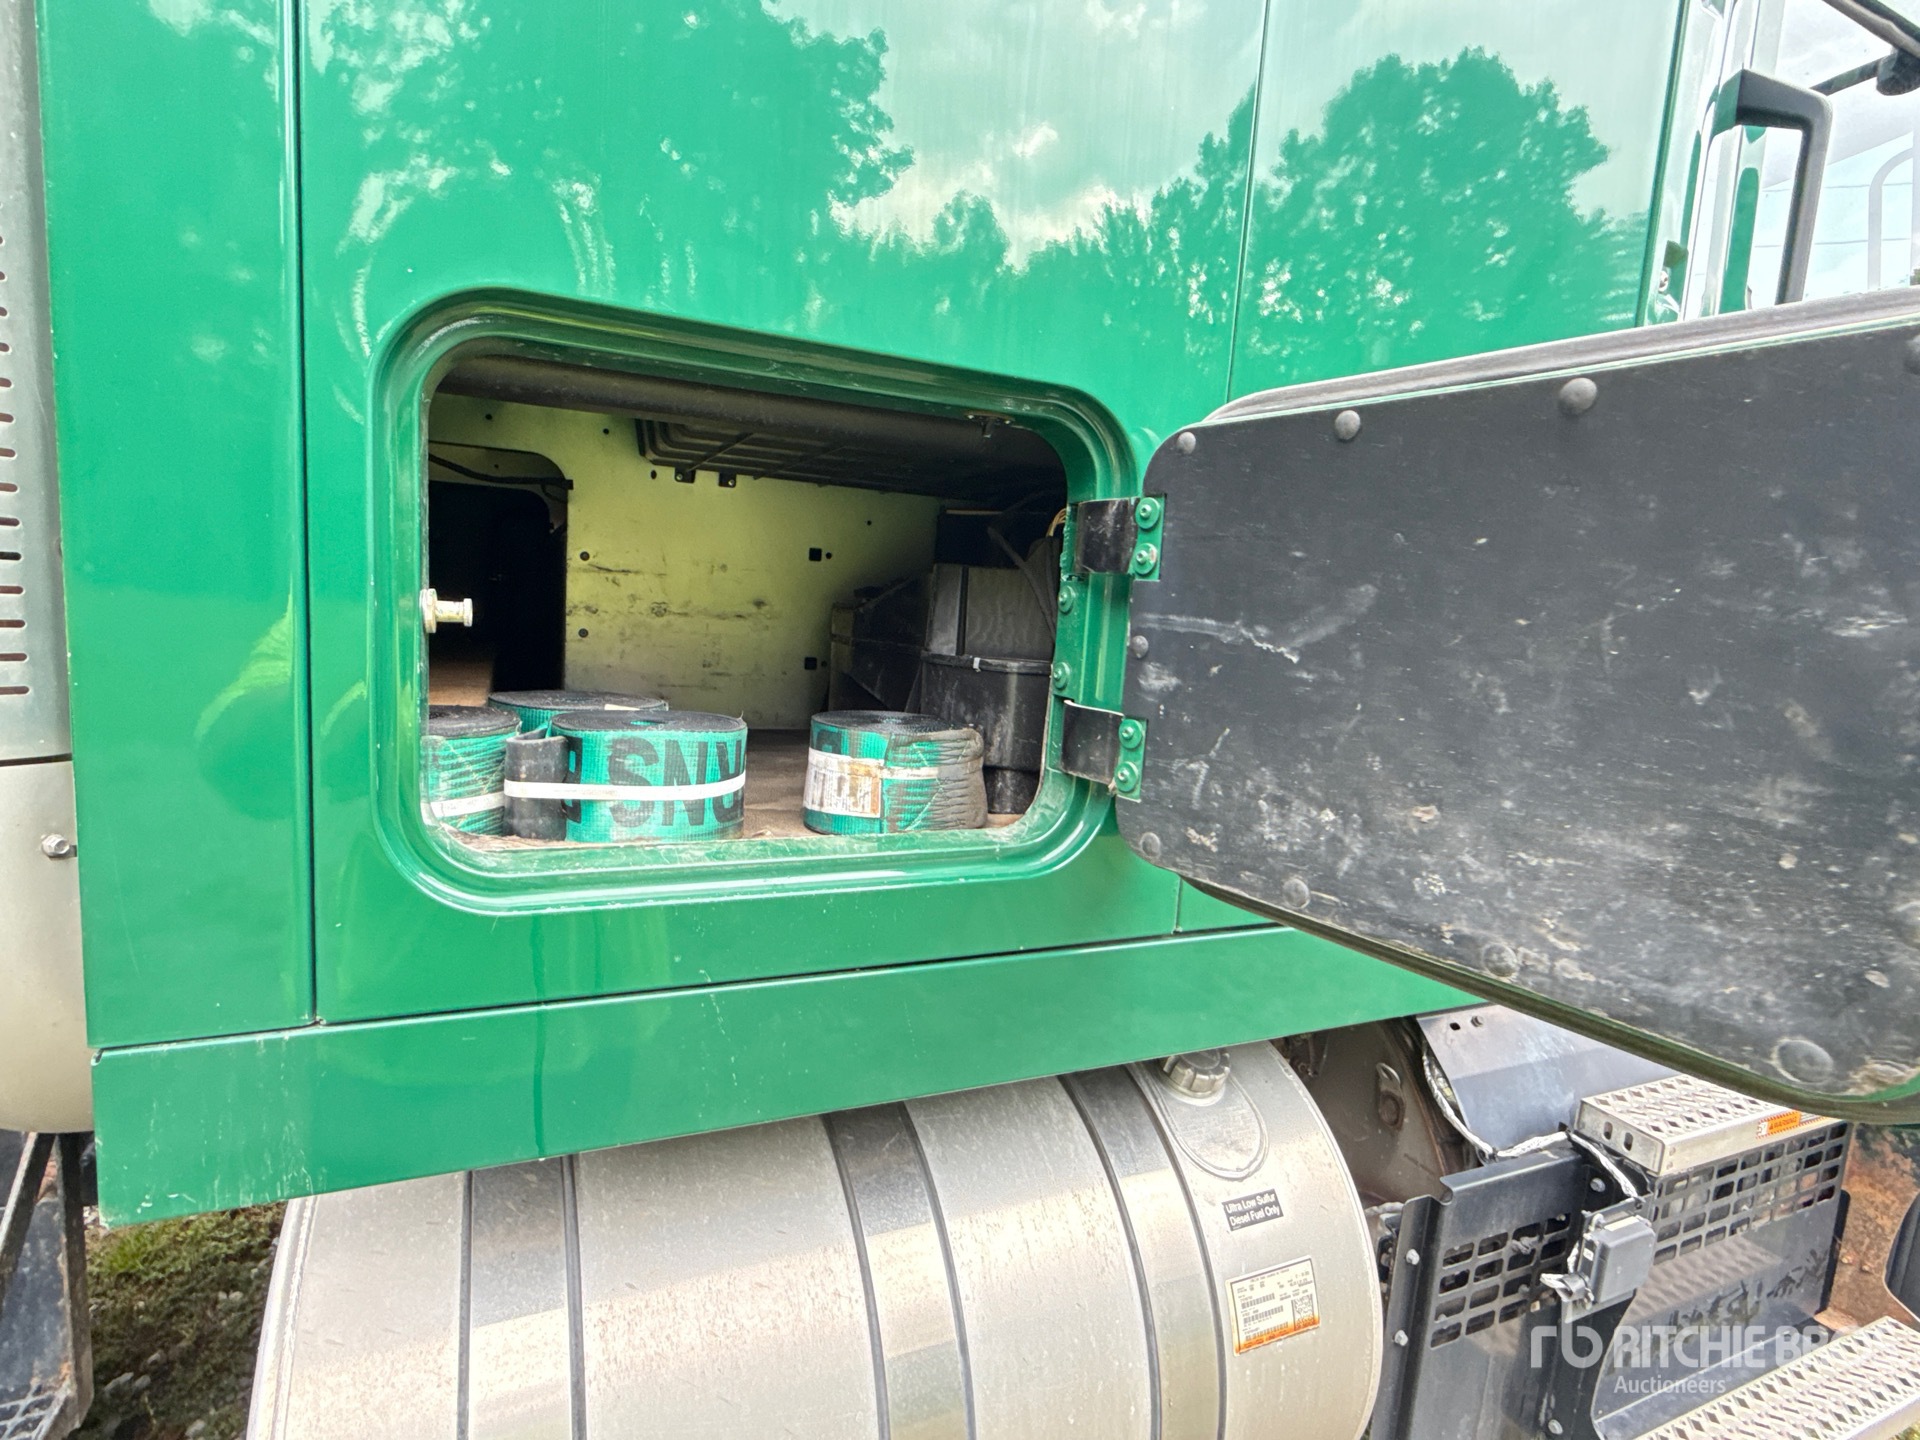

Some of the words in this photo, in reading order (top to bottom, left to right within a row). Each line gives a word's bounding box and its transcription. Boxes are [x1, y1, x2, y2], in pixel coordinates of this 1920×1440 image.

[1225, 1202, 1243, 1214] Ultra
[1241, 1199, 1257, 1210] Low
[1255, 1193, 1275, 1206] Sulfur
[1229, 1212, 1250, 1226] Diesel
[1249, 1208, 1265, 1220] Fuel
[1264, 1204, 1280, 1217] Only
